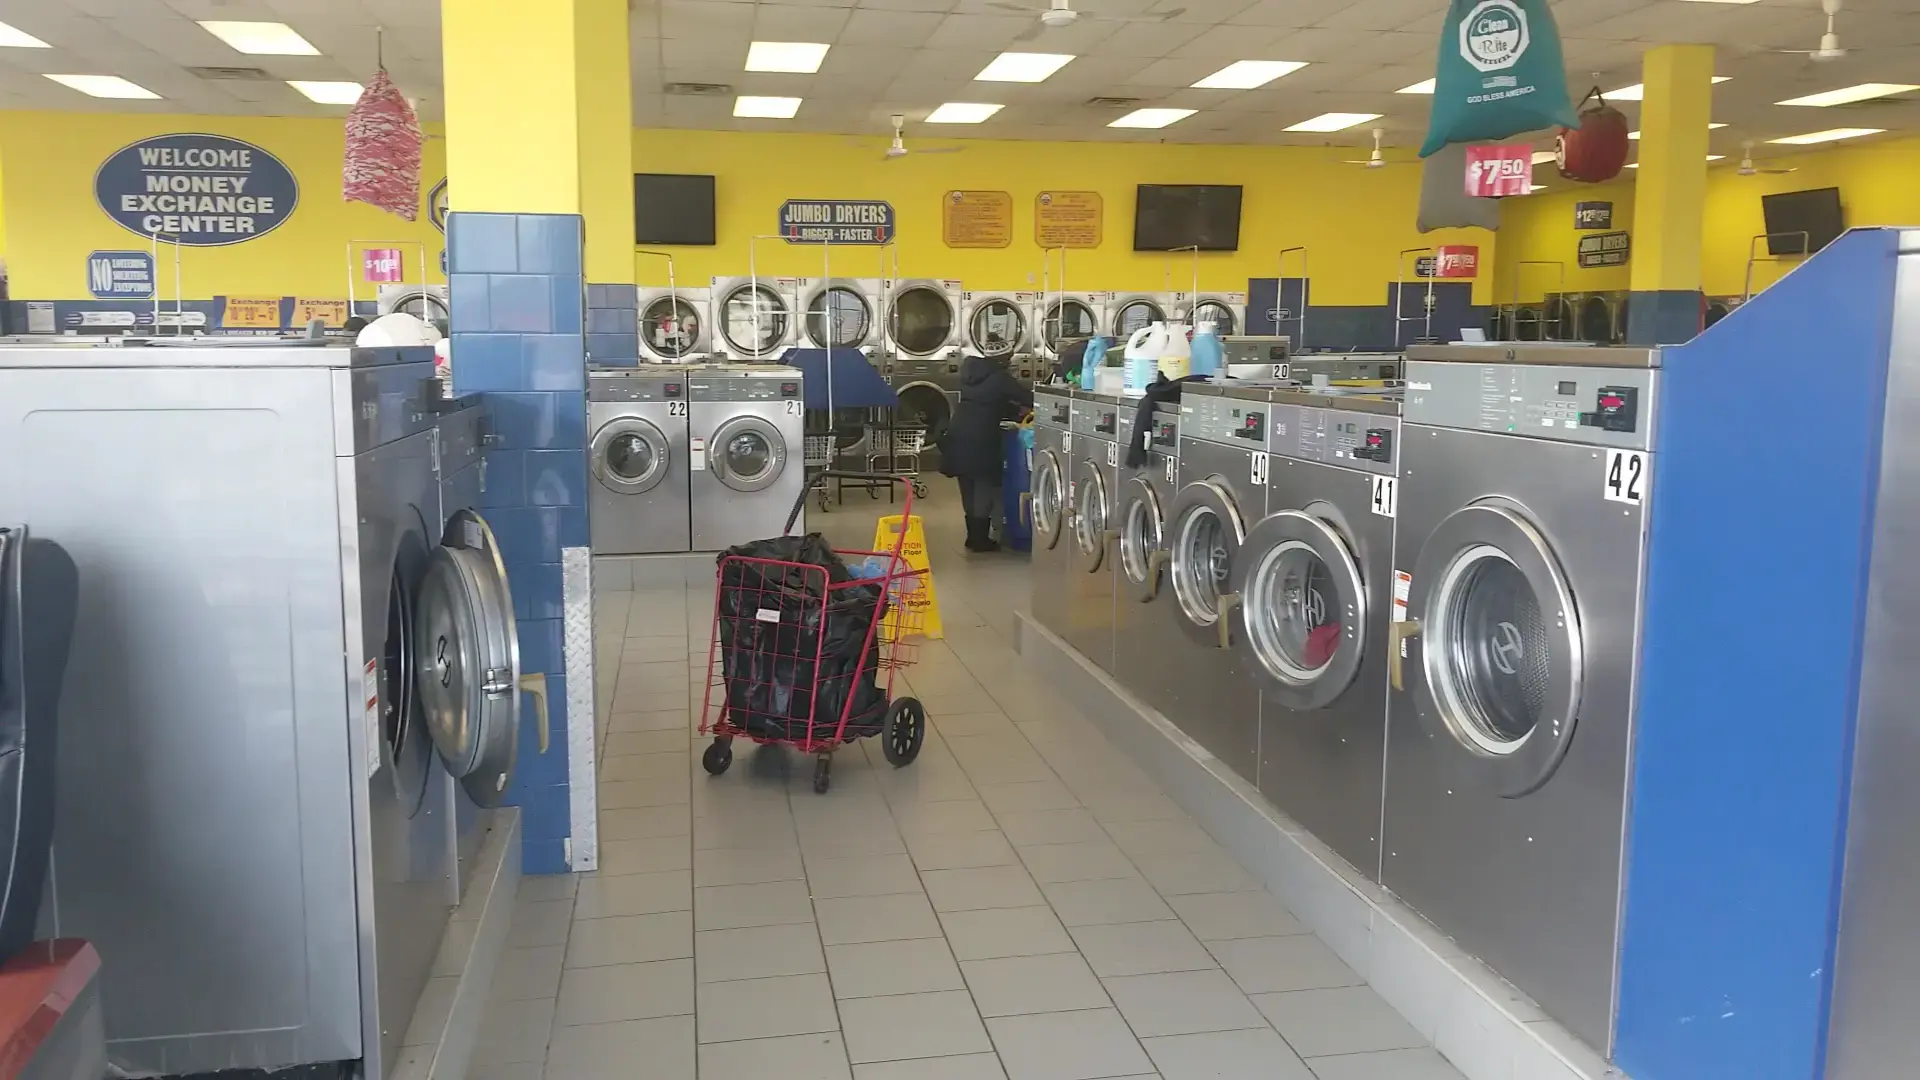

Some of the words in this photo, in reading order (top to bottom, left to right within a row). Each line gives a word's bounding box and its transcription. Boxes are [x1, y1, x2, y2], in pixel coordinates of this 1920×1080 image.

[1478, 18, 1509, 34] Clean
[1481, 37, 1508, 54] Rite
[1466, 95, 1482, 104] GOD
[1483, 91, 1504, 102] BLESS
[1505, 85, 1536, 98] AMERICA
[138, 147, 252, 168] WELCOME
[146, 175, 248, 194] MONEY
[120, 194, 275, 214] EXCHANGE
[142, 214, 256, 233] CENTER
[785, 204, 831, 223] JUMBO
[836, 204, 887, 224] DRYERS
[91, 258, 113, 292] NO
[963, 292, 971, 301] 15
[1035, 291, 1044, 300] 17
[1176, 292, 1185, 301] 21
[1274, 365, 1288, 378] 20
[669, 402, 686, 417] 22
[787, 401, 802, 416] 21
[1253, 454, 1266, 483] 40
[1608, 452, 1642, 500] 42
[1375, 478, 1393, 514] 41
[887, 542, 922, 551] CTION
